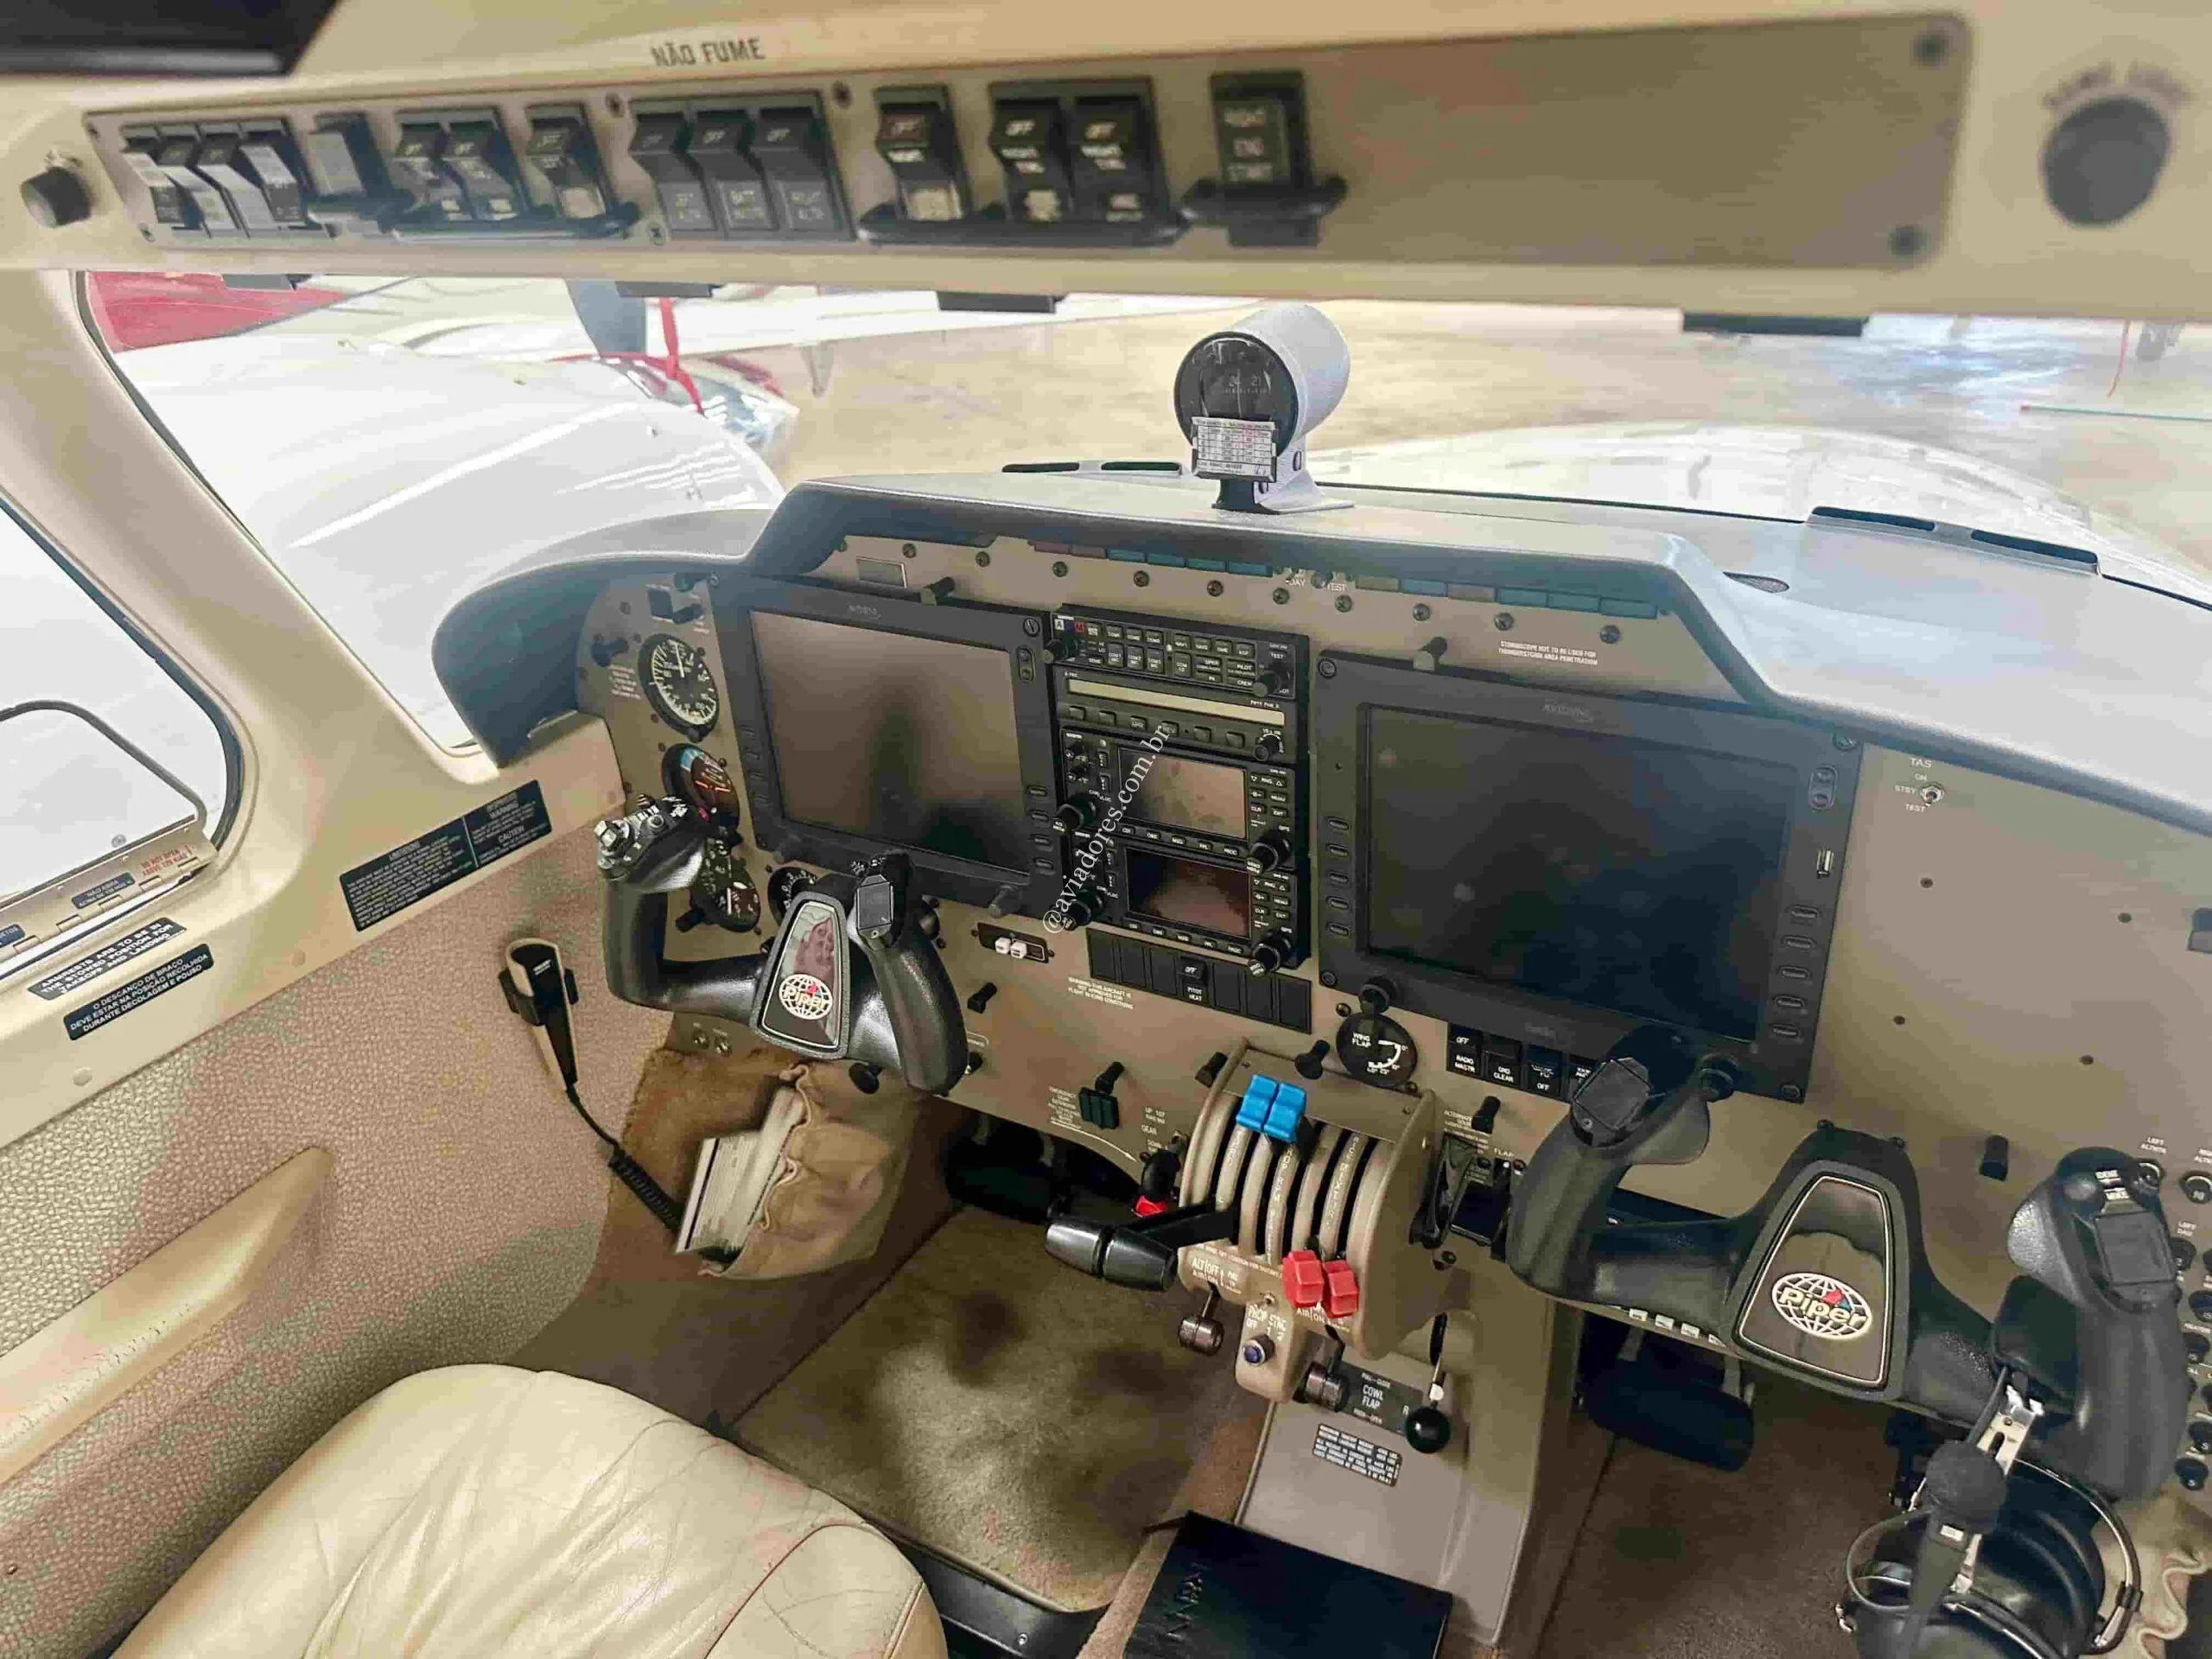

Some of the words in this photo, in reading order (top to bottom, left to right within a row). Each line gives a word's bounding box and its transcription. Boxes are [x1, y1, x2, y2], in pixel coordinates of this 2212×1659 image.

[651, 41, 696, 67] NÃO
[701, 37, 766, 62] FUME
[1910, 758, 1932, 768] TAS
[1905, 804, 1926, 812] TEST
[107, 955, 128, 967] AND
[130, 934, 171, 956] LANDING
[41, 982, 62, 993] THE
[64, 959, 106, 982] STOWED
[109, 936, 151, 959] POSITION
[154, 925, 174, 937] FOR
[42, 959, 93, 988] ARMRESTS
[96, 947, 116, 959] ARE
[118, 938, 132, 948] TO
[145, 973, 156, 983] DE
[70, 1014, 92, 1031] DEVE
[92, 1001, 119, 1020] ESTAR
[119, 995, 132, 1005] NA
[167, 954, 209, 980] RECOLHIDA
[83, 1008, 121, 1032] DURANTE
[121, 982, 169, 1011] DECOLAGEM
[177, 964, 202, 982] POUSO
[1352, 1031, 1370, 1042] WING
[1456, 1036, 1469, 1045] OFF
[1351, 1038, 1371, 1048] FLAP
[1456, 1054, 1474, 1065] RADIO
[1493, 1072, 1514, 1083] CLEAR
[1141, 1124, 1157, 1135] GEAR
[2146, 1136, 2164, 1146] LEFT
[1493, 1147, 1515, 1157] FLAP
[1192, 1257, 1205, 1270] ALT
[1207, 1263, 1221, 1275] OFF
[1777, 1286, 1867, 1326] Piper
[1363, 1383, 1383, 1401] COWL
[1362, 1395, 1381, 1410] FLAP
[1402, 1405, 1409, 1416] R
